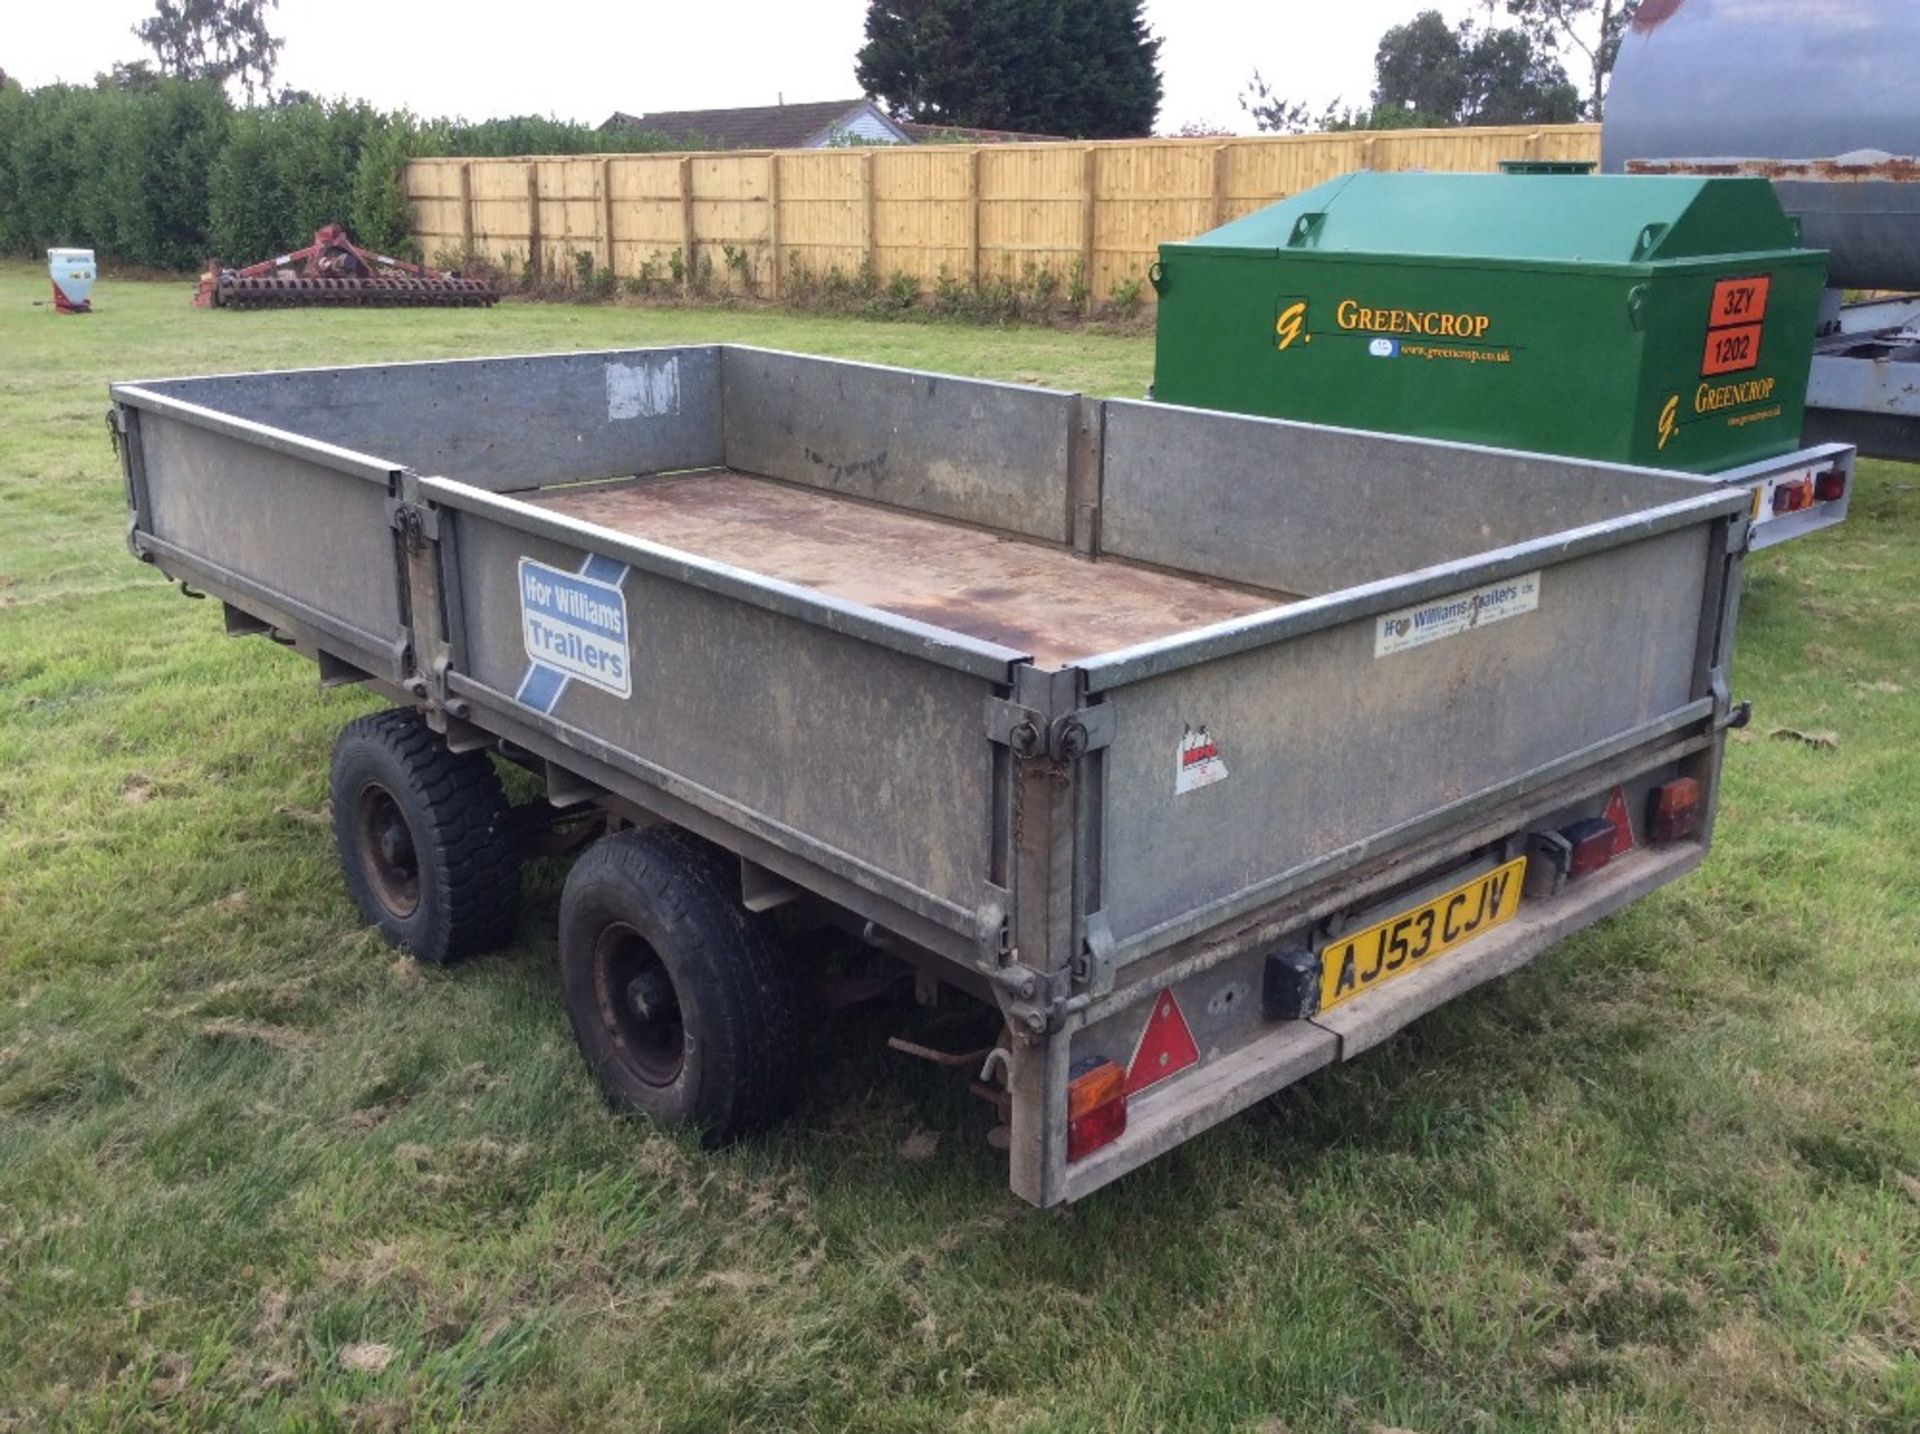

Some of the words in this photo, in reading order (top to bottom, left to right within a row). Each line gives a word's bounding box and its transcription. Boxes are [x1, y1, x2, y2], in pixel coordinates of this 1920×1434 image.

[1723, 287, 1756, 316] 3ZY
[1714, 334, 1750, 364] 1202
[525, 575, 551, 607] Ifor
[555, 585, 621, 634] Williams
[1413, 600, 1468, 628] Williams
[1471, 585, 1518, 609] Trailers
[528, 617, 623, 679] Trailers
[1333, 908, 1436, 998] AJ53
[1441, 871, 1511, 944] CJV
